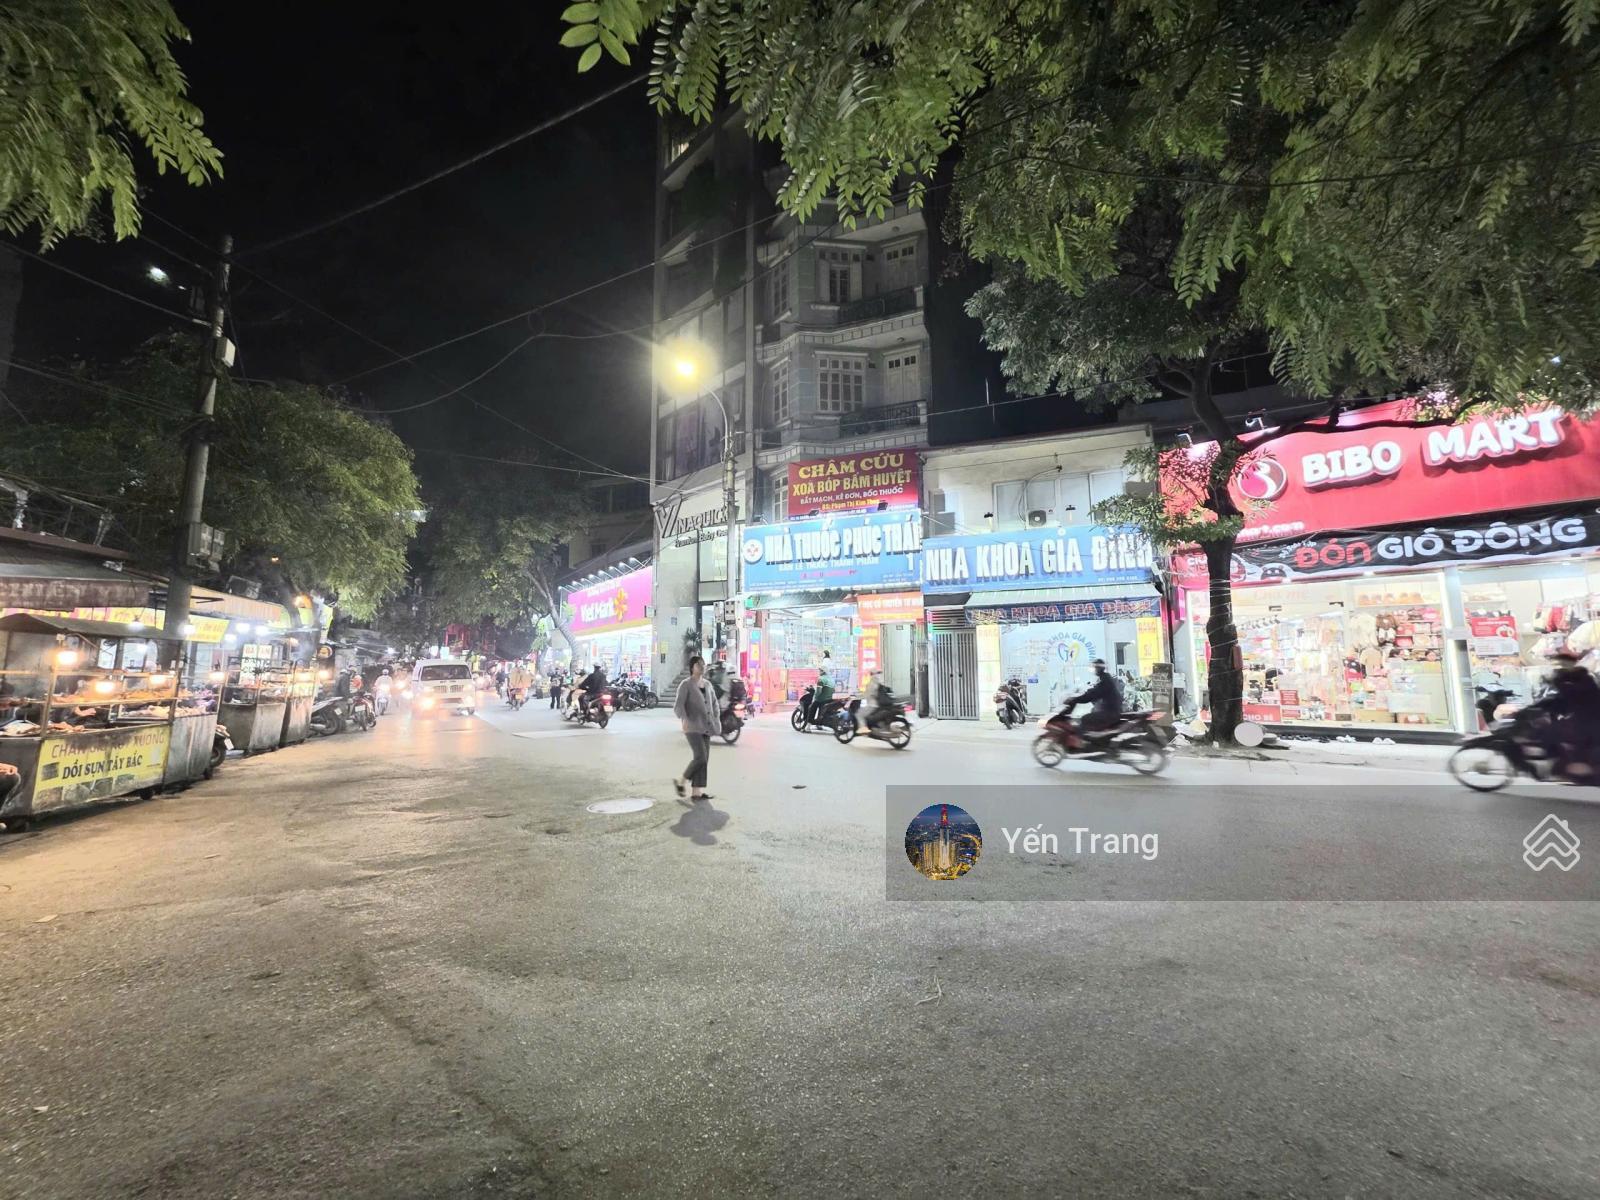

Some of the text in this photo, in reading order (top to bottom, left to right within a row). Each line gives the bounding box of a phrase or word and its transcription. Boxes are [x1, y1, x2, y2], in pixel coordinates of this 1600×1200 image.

[1302, 405, 1565, 483] BIBO MART
[798, 459, 856, 479] CHÂM
[818, 477, 841, 493] BÓP
[873, 468, 912, 487] HUYỆT
[764, 527, 793, 563] NHÀ
[793, 518, 842, 561] THUỐC
[1377, 527, 1444, 559] GIÓ
[1452, 518, 1587, 553] ĐÔNG
[926, 547, 969, 581] NHA
[976, 541, 1035, 578] KHOA
[1011, 605, 1059, 619] KHOA
